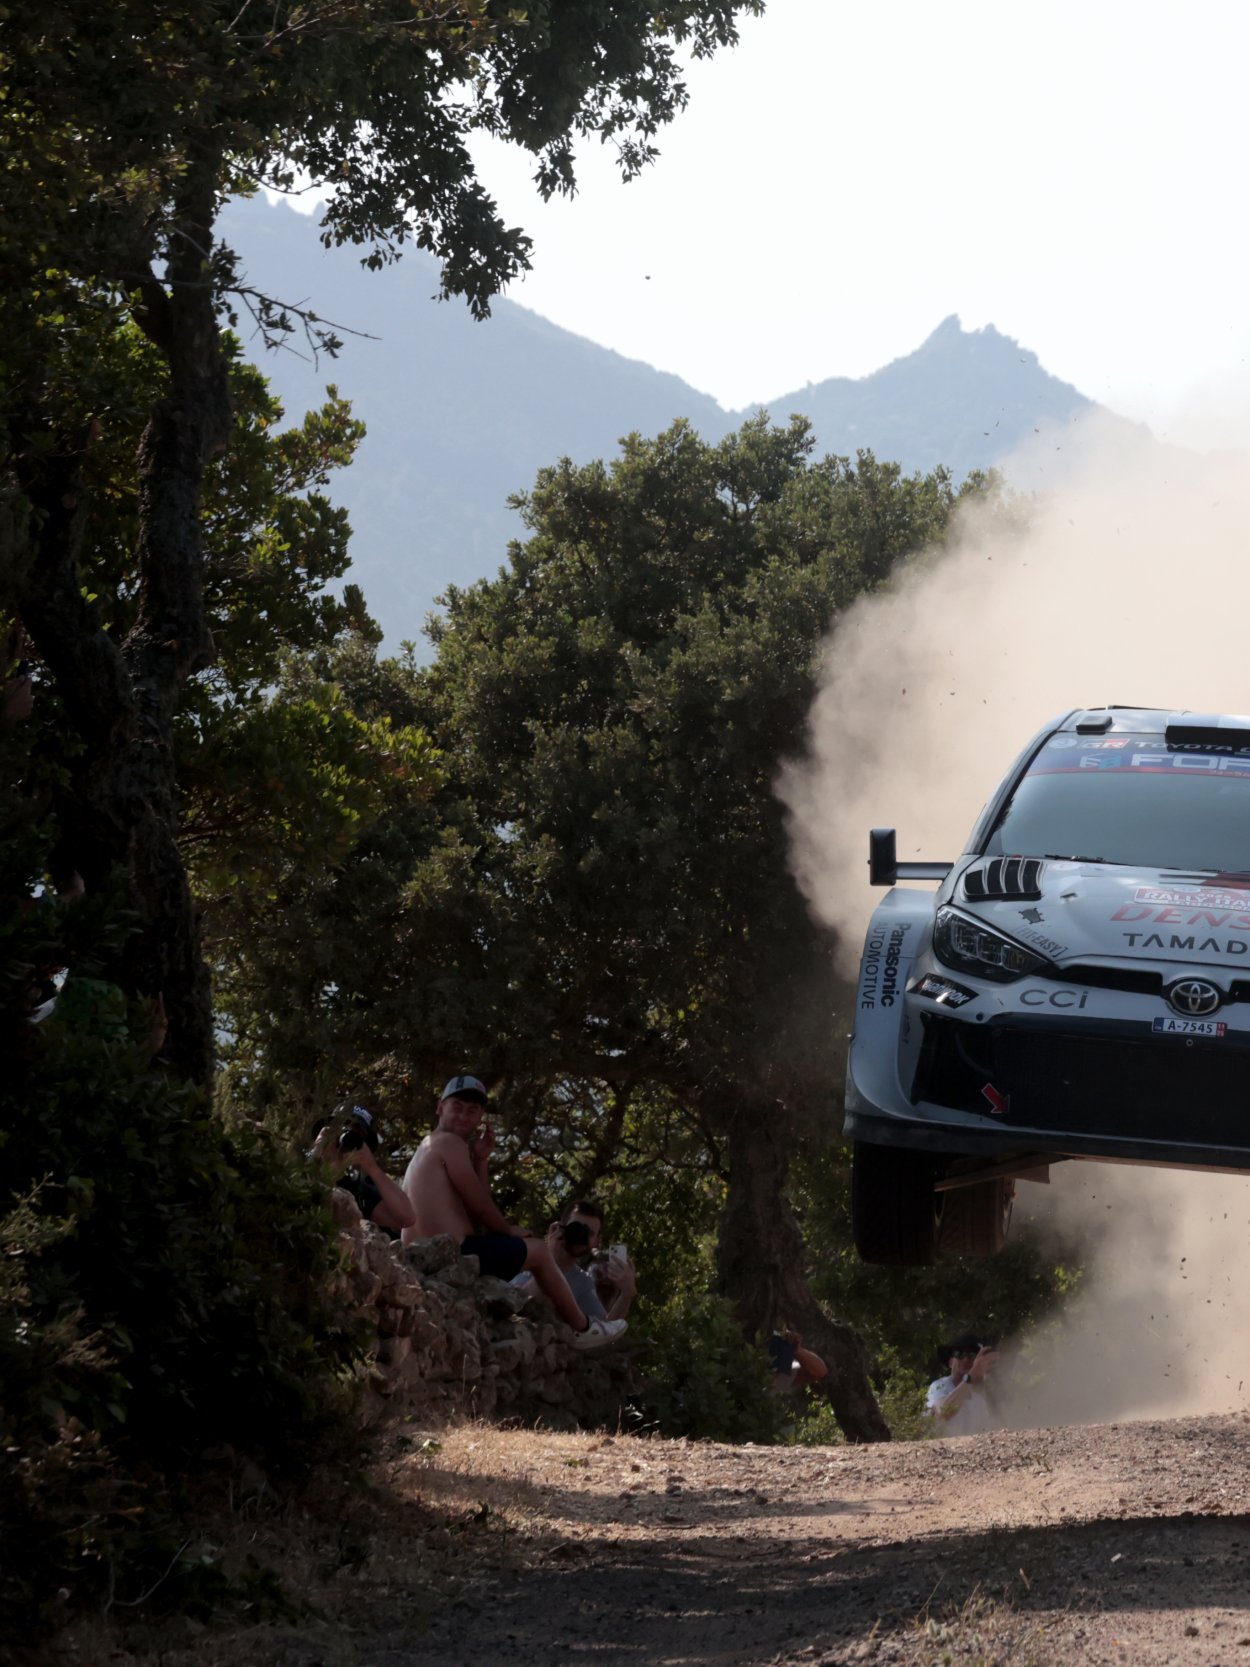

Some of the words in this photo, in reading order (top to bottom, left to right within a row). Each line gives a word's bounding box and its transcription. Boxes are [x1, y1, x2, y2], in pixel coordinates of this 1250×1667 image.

[1133, 741, 1233, 751] TOYOTA
[1143, 891, 1208, 903] RALLY
[861, 921, 888, 1010] AUTOMOTIVE
[880, 922, 912, 1008] Panasonic
[1167, 1020, 1213, 1034] A-7545
